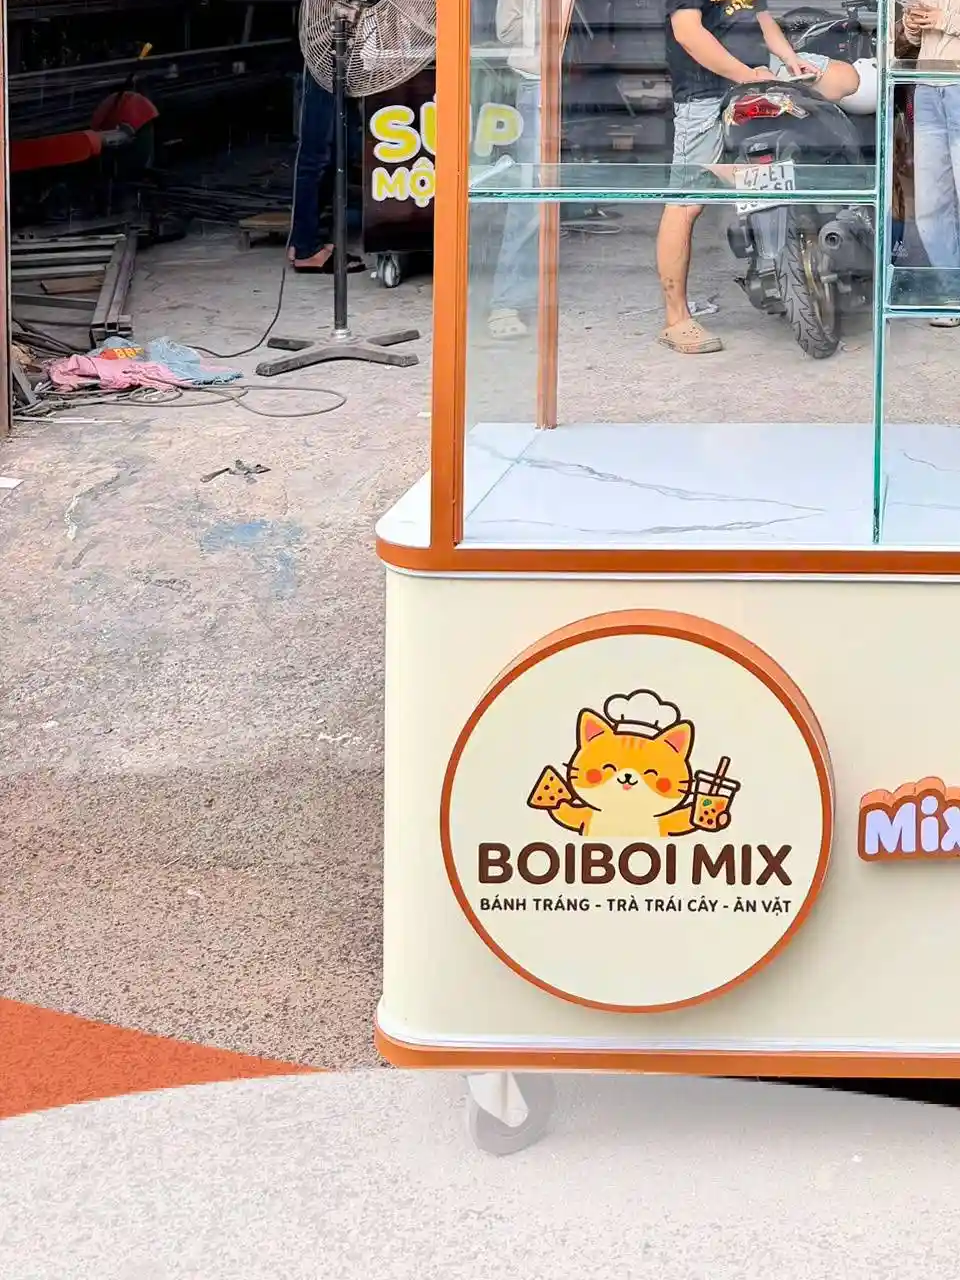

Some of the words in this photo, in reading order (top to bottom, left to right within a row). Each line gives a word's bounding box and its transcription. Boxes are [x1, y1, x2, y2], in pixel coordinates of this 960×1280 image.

[478, 841, 676, 885] BOIBOI
[691, 843, 793, 886] MIX
[480, 894, 527, 911] BÁNH
[533, 894, 590, 912] TRÁNG
[607, 894, 640, 912] TRÀ
[645, 895, 682, 912] TRÁI
[687, 896, 719, 913] CÂY
[733, 895, 757, 913] ĂN
[761, 895, 793, 917] VẶT
